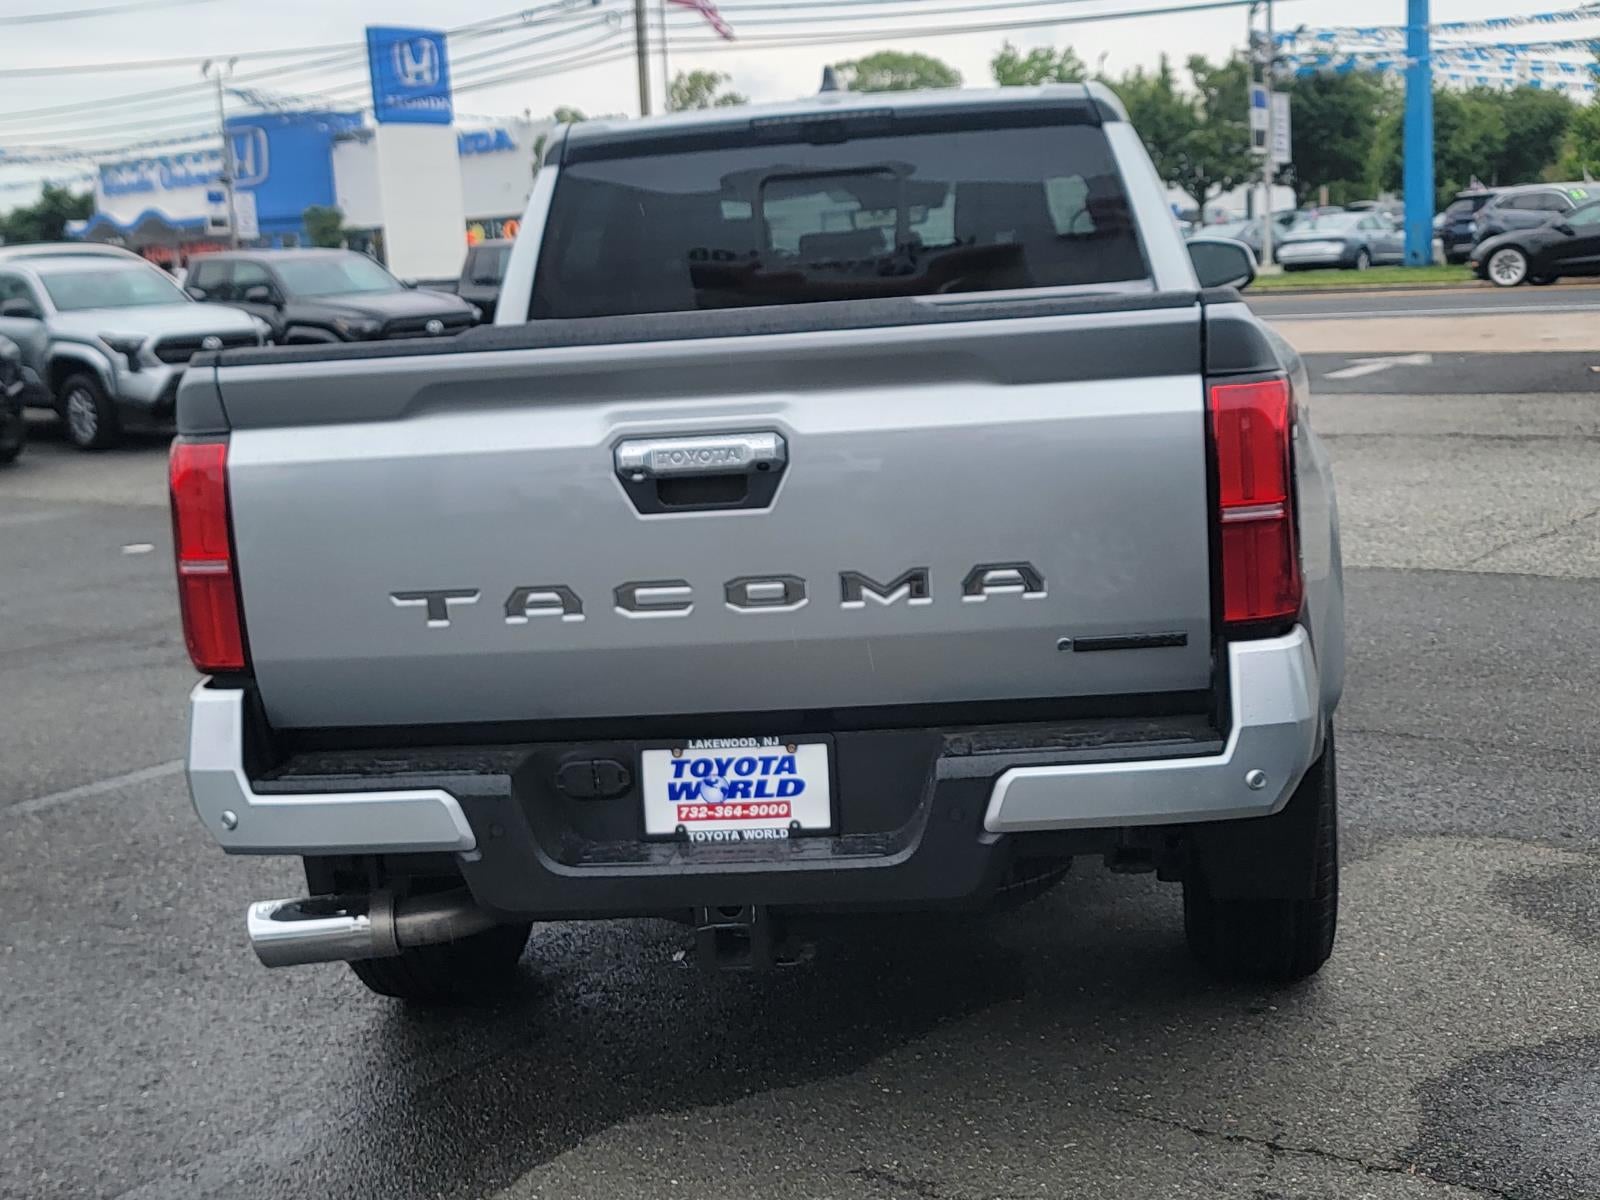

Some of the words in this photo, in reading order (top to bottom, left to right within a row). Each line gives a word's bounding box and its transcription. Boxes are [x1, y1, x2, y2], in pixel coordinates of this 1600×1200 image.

[658, 447, 742, 466] TOYOTA
[390, 560, 1049, 628] TACOMA
[688, 738, 761, 750] LAKEWOOD,
[763, 736, 780, 746] NJ
[671, 755, 798, 779] TOYOTA
[679, 804, 788, 819] 732-364-9000
[688, 831, 740, 842] TOYOTA
[742, 828, 789, 840] WORLD
